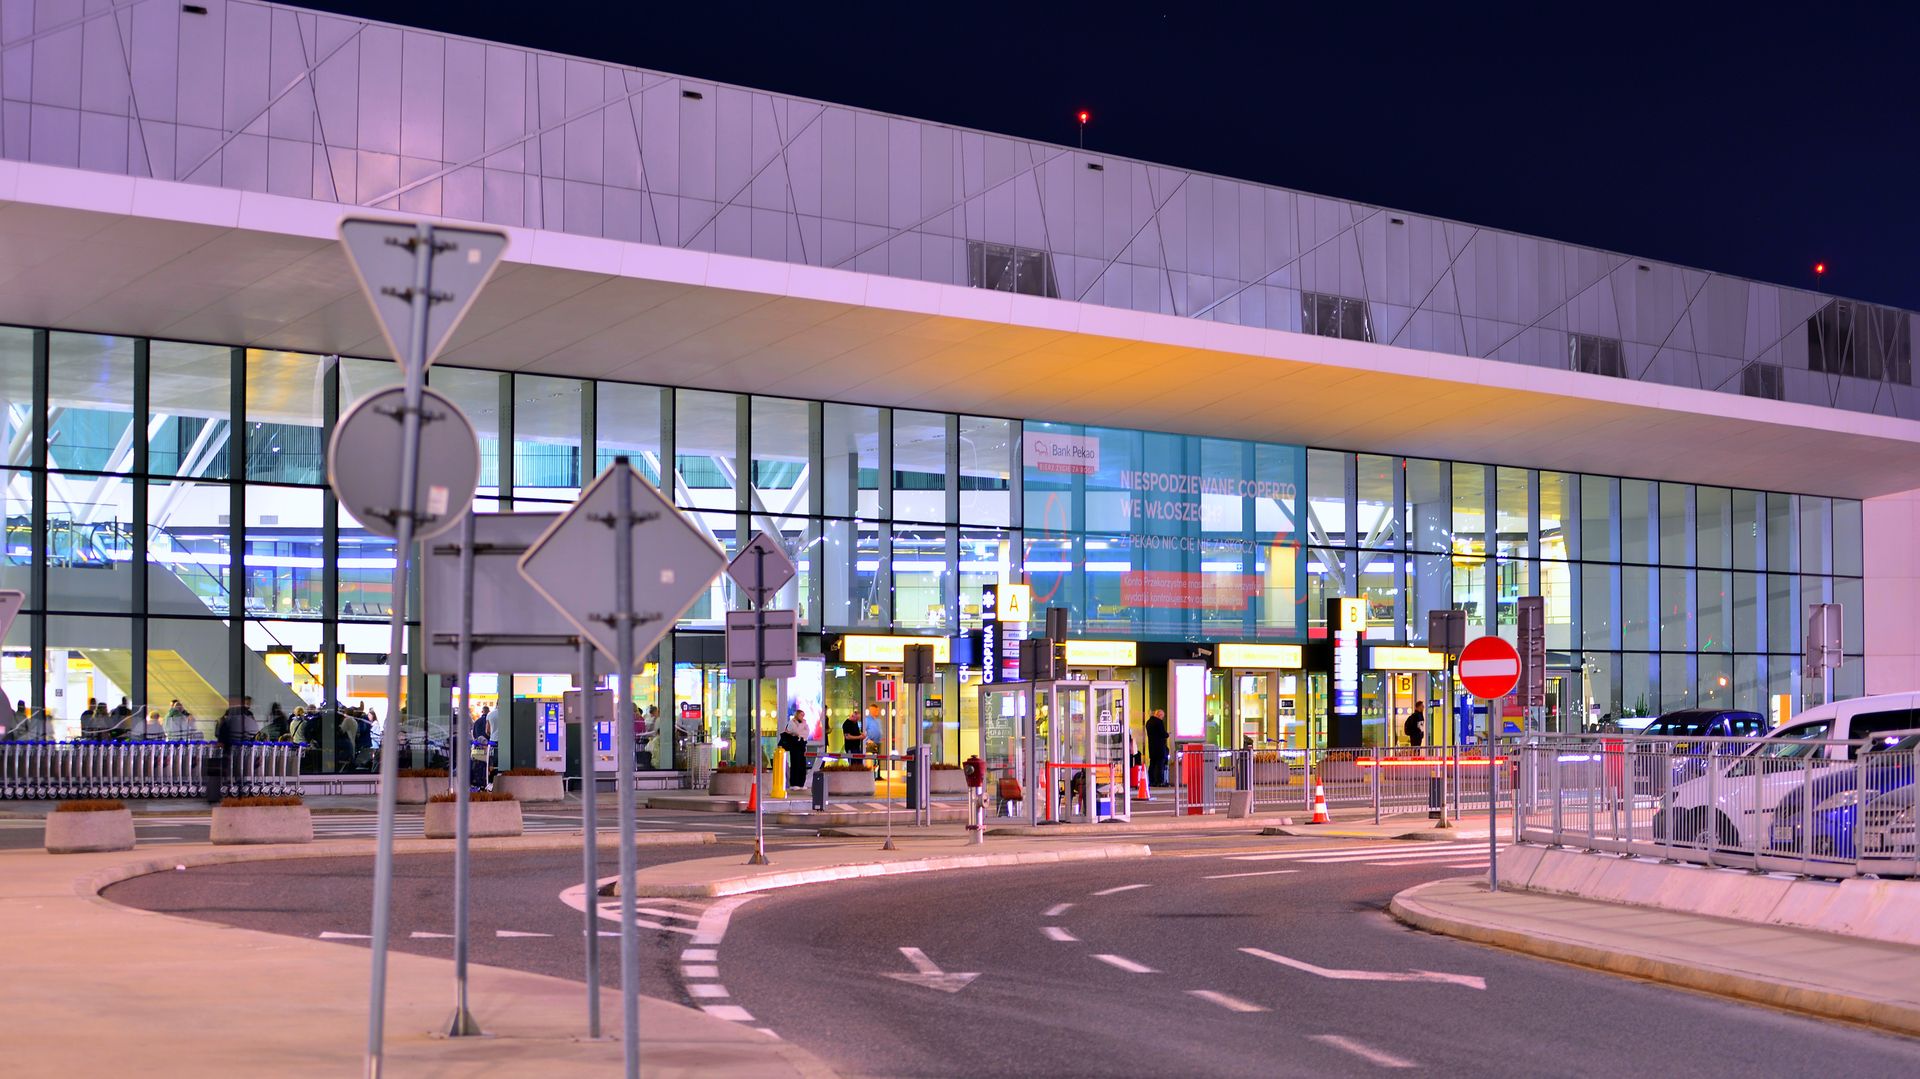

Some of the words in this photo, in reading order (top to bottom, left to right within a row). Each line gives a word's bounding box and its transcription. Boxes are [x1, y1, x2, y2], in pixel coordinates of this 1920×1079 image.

[1052, 444, 1071, 457] Bank
[1072, 446, 1095, 459] Pekao
[1120, 470, 1235, 496] NIESPODZIEWANE
[1238, 480, 1296, 500] COPERTO
[1120, 499, 1142, 519] WE
[1129, 534, 1160, 550] PEKAO
[1162, 536, 1178, 551] NIC
[1180, 537, 1195, 554] CIĘ
[1009, 594, 1018, 612] A
[1351, 607, 1357, 622] B
[984, 625, 993, 683] CHOPINA
[882, 683, 890, 699] H
[1402, 677, 1411, 691] B
